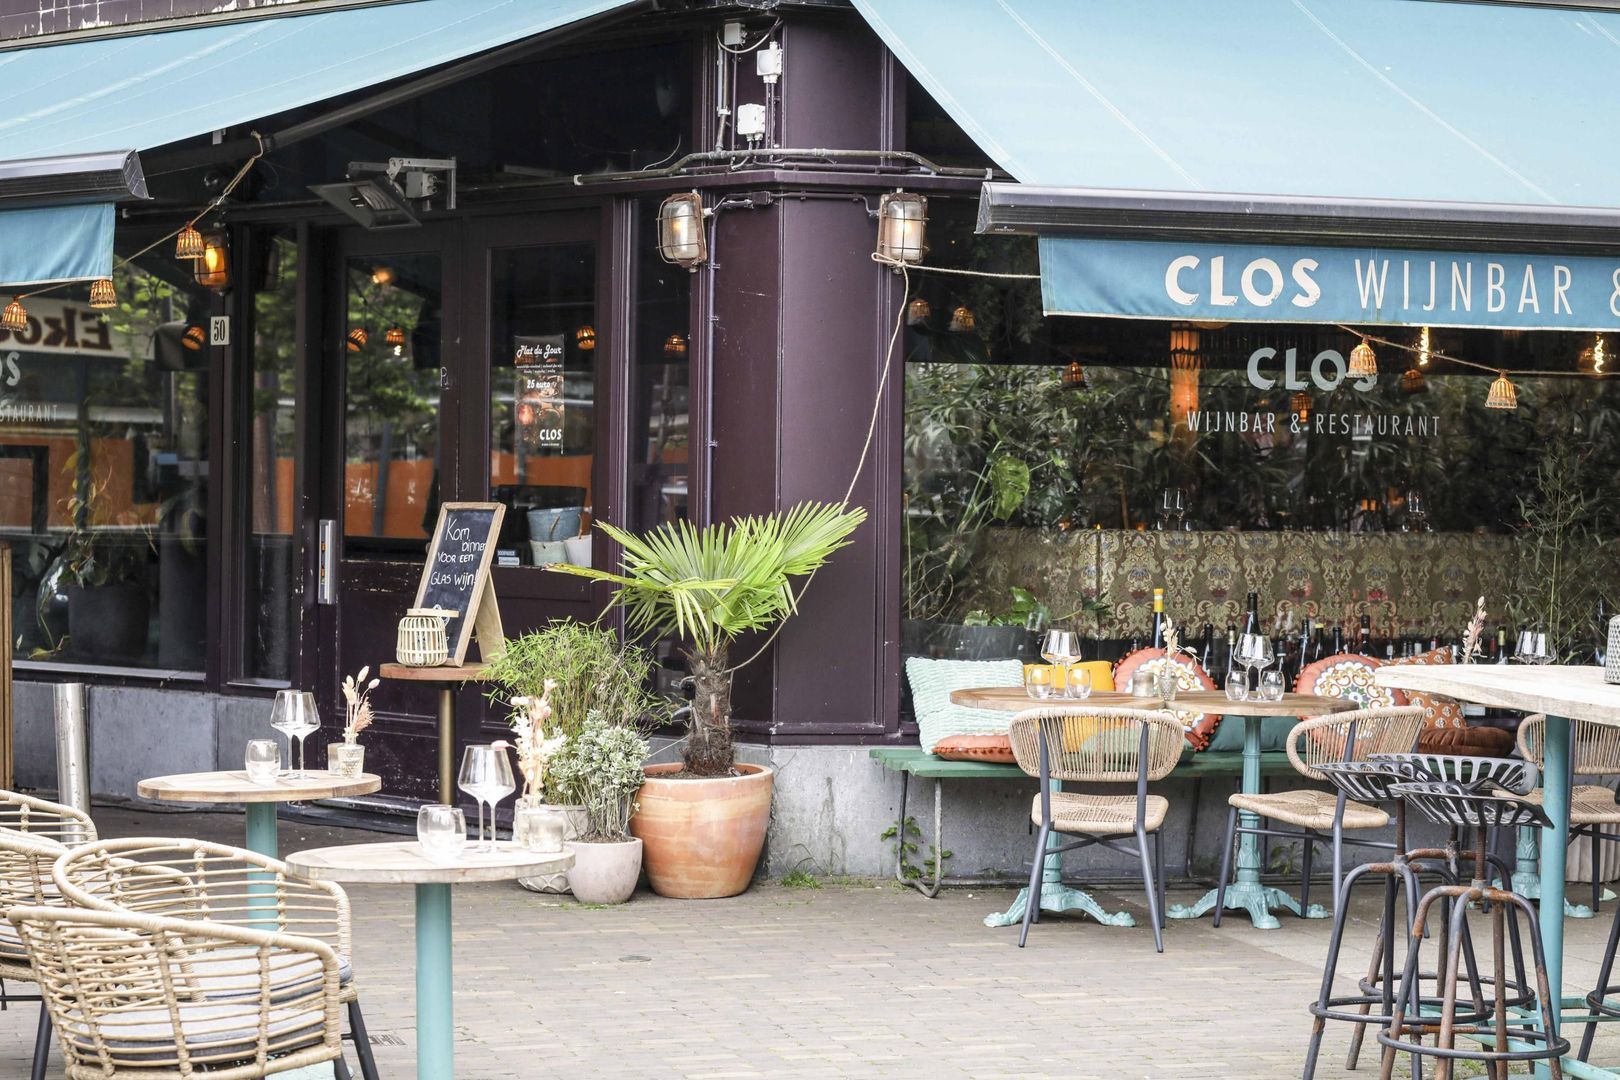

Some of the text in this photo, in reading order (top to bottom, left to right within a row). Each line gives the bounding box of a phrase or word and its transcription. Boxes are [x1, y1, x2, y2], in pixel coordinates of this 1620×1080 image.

[1164, 255, 1321, 307] CLOS
[1355, 259, 1573, 315] WIJNBAR
[213, 320, 226, 342] 50
[534, 344, 543, 355] du
[539, 429, 562, 441] CLOS
[1187, 411, 1440, 437] WIJNBAR & RESTAURANT
[445, 517, 470, 540] Kom
